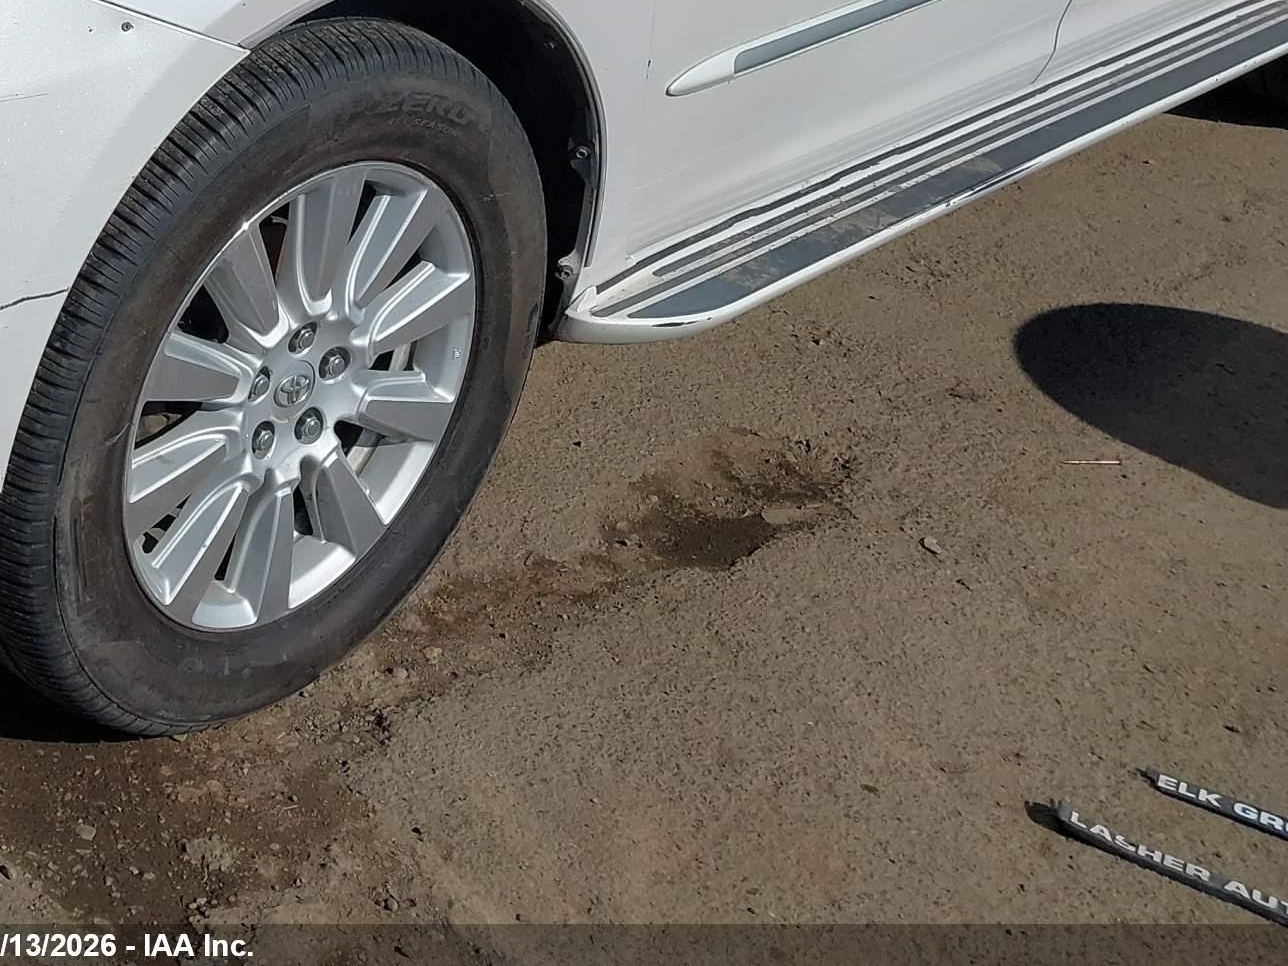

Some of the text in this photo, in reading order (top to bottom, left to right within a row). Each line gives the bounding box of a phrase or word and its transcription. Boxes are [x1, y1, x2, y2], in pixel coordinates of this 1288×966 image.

[1158, 774, 1288, 831] ELK GR
[1070, 811, 1211, 881] LASHER
